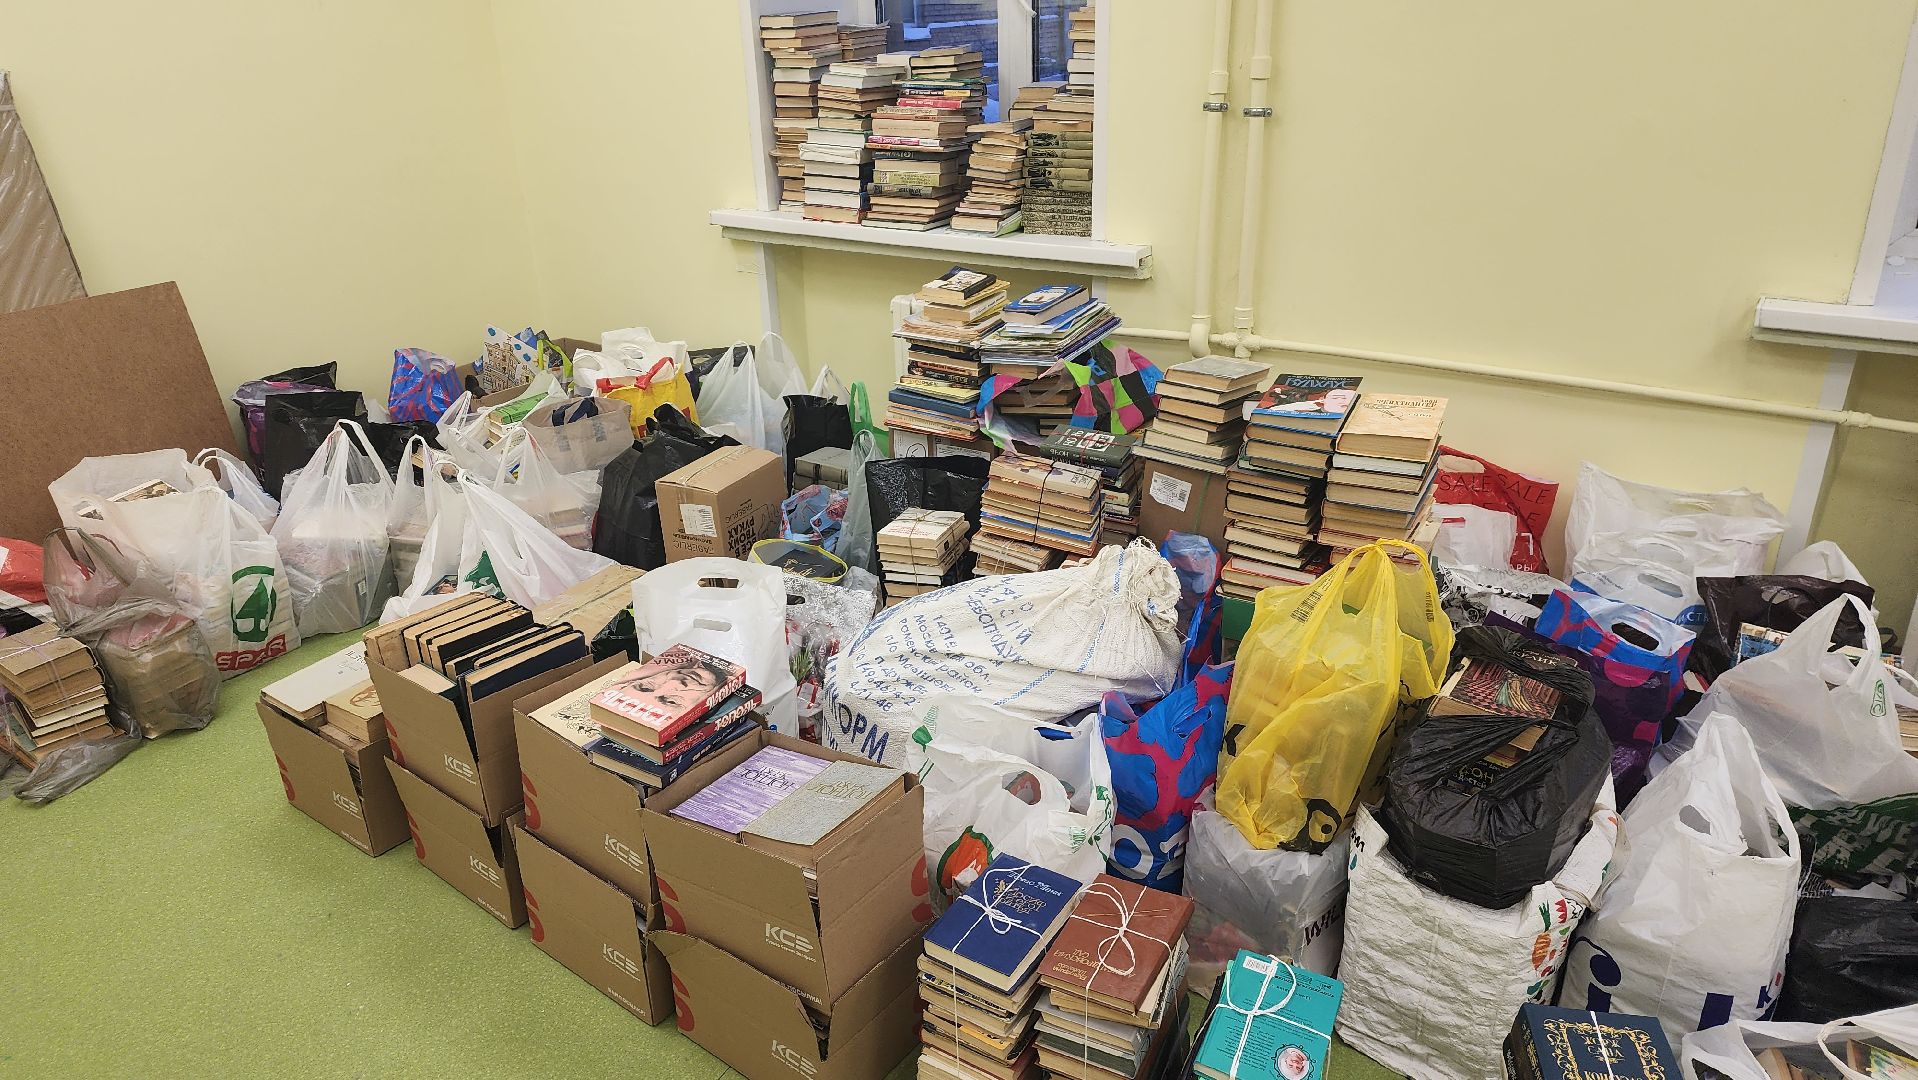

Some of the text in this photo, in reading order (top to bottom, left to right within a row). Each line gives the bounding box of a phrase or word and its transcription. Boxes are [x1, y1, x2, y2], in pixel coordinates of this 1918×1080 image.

[1439, 473, 1552, 504] SALE SALE
[728, 515, 755, 540] РУКАХ
[728, 529, 757, 551] ТВОИХ
[217, 638, 284, 669] SPAR
